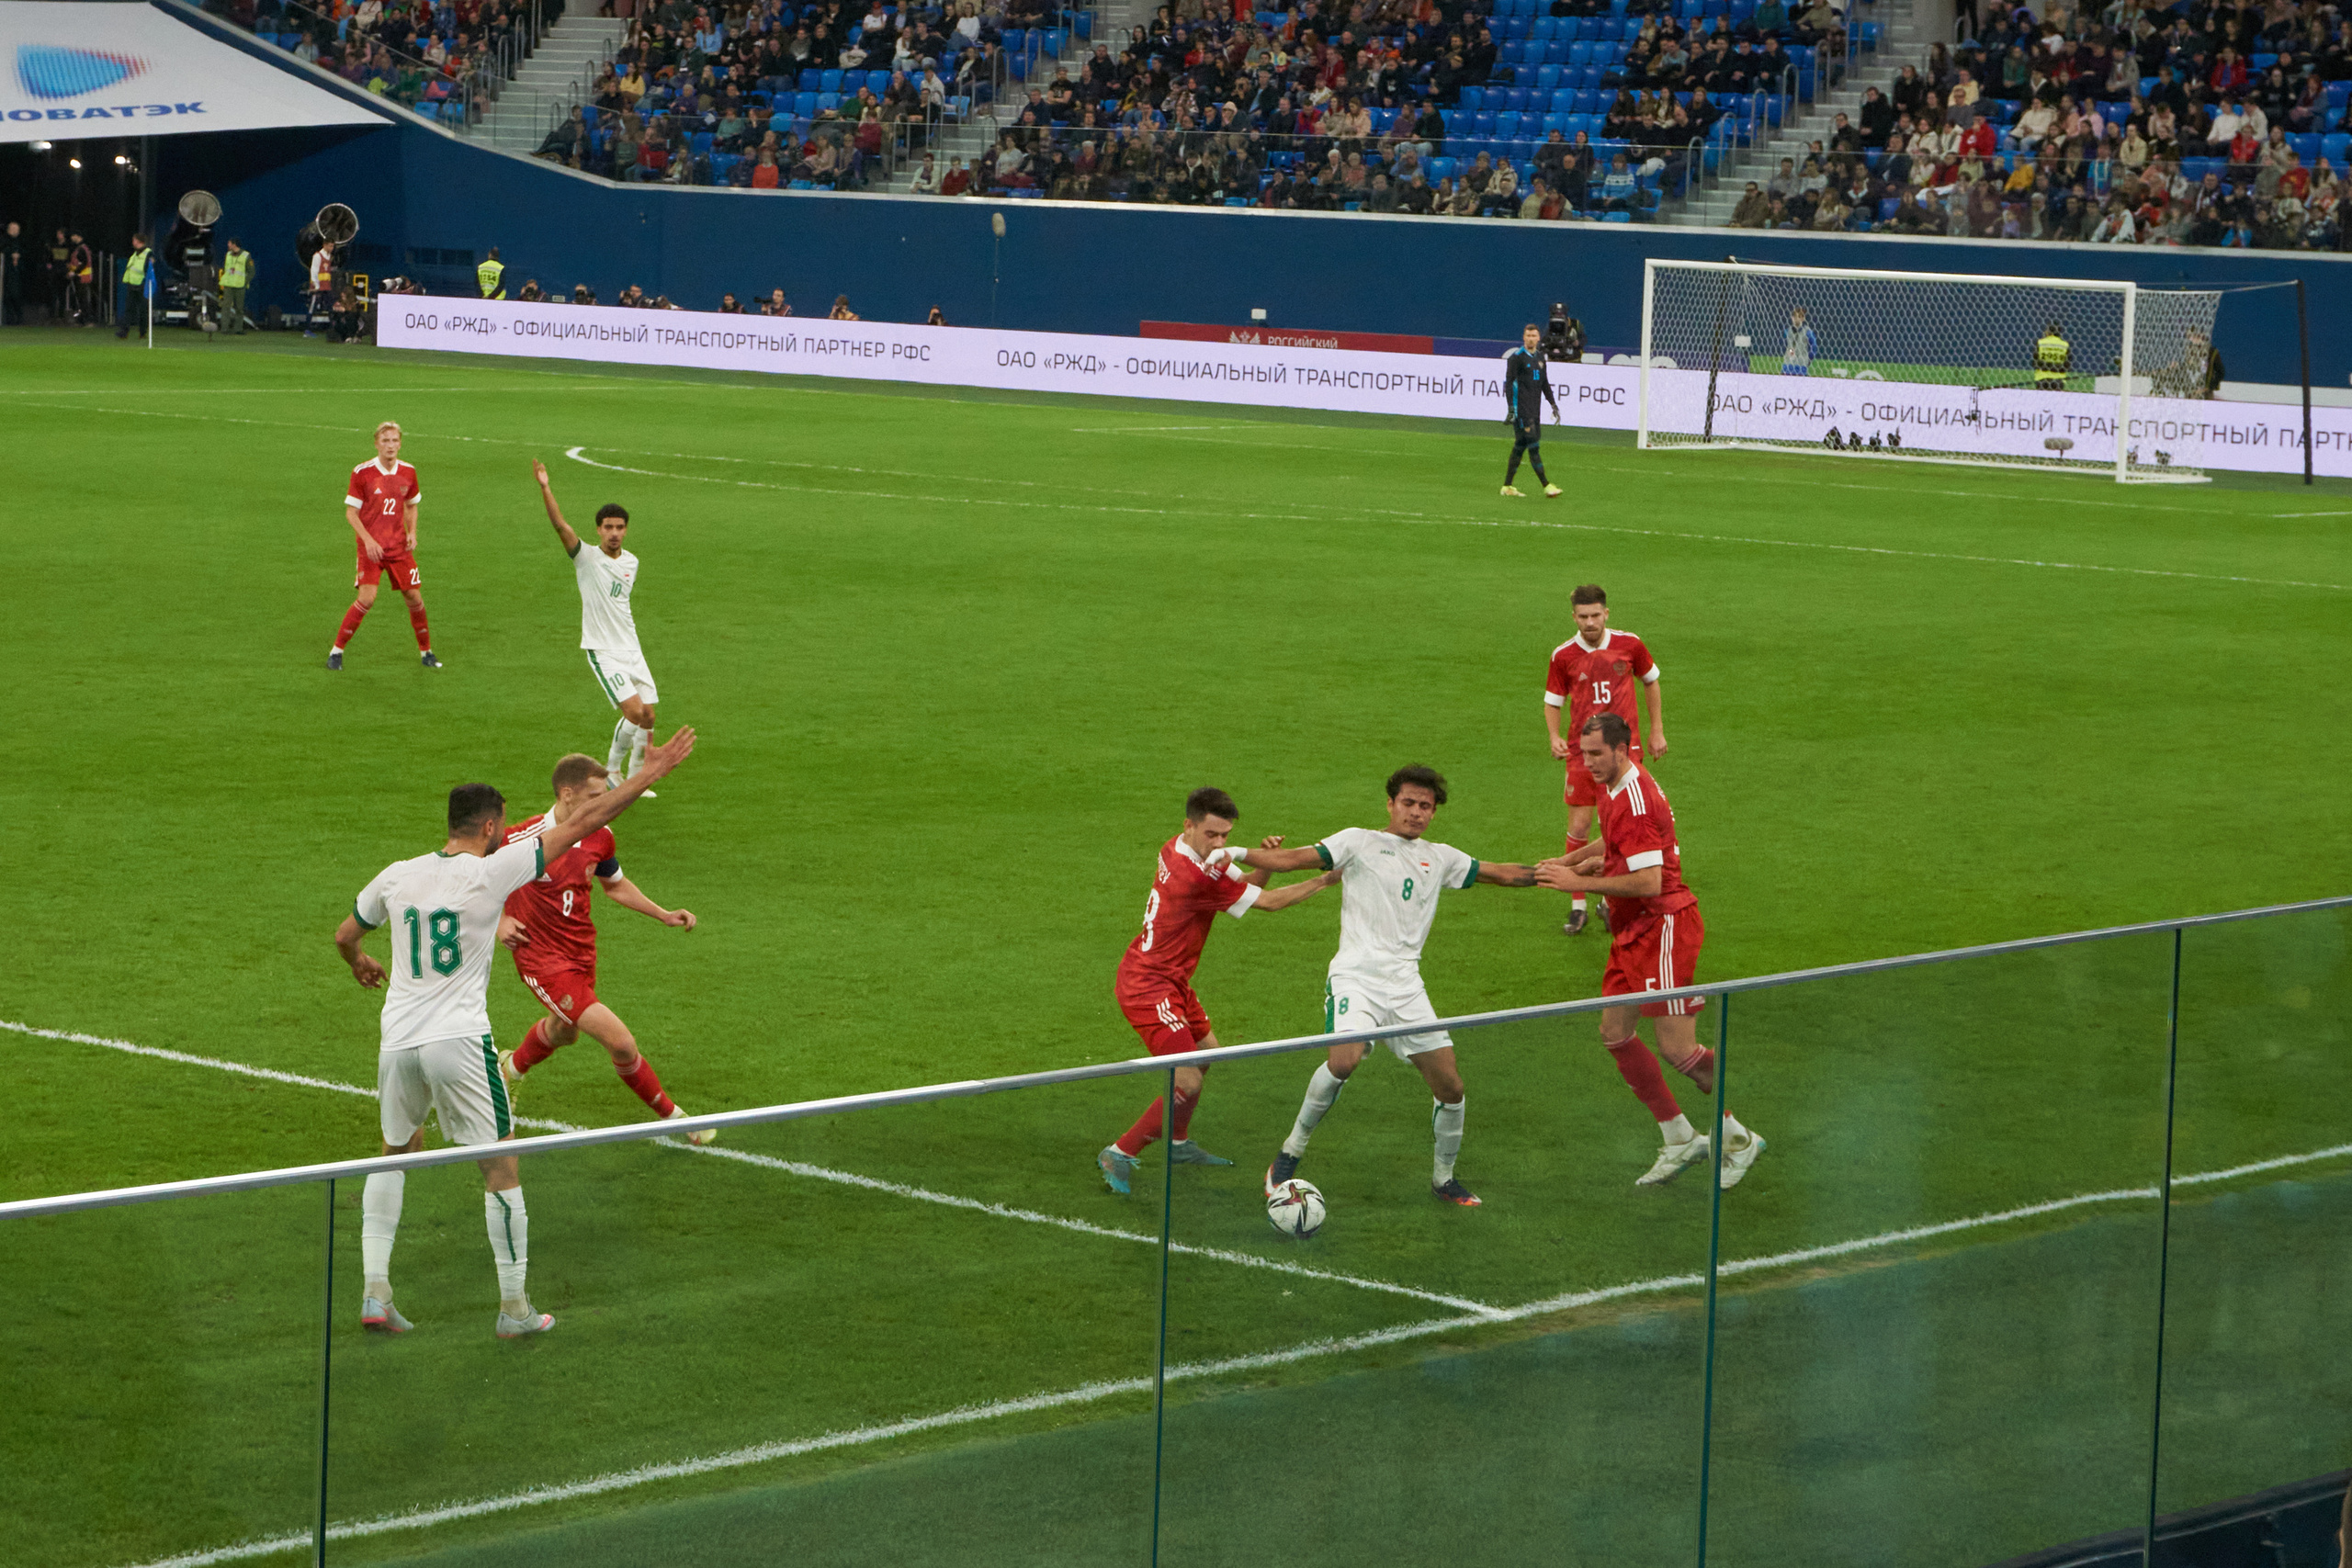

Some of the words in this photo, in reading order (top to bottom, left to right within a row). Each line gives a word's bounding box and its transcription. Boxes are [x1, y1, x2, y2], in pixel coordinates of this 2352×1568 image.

[0, 102, 207, 121] ОВАТЭК
[405, 313, 437, 330] ОАО
[444, 316, 497, 335] «РЖД»
[514, 321, 649, 343] ОФИЦИАЛЬНЫЙ
[655, 329, 797, 352] ТРАНСПОРТНЫЙ
[804, 338, 885, 357] ПАРТНЕР
[892, 344, 931, 361] РФС
[997, 350, 1036, 367] ОАО
[1044, 354, 1106, 375] «РЖД»
[1126, 357, 1287, 384] ОФИЦИАЛЬНЫЙ
[1295, 368, 1464, 396] ТРАНСПОРТНЫЙ
[1578, 386, 1626, 405] РФС
[1762, 398, 1838, 422] «РЖД»
[382, 498, 396, 515] 22
[410, 568, 422, 585] 22
[610, 581, 622, 598] 10
[609, 673, 625, 691] 10
[1592, 681, 1611, 705] 15
[1402, 877, 1414, 901] 8
[562, 889, 574, 917] 8
[403, 906, 463, 979] 18
[1339, 998, 1349, 1015] 8
